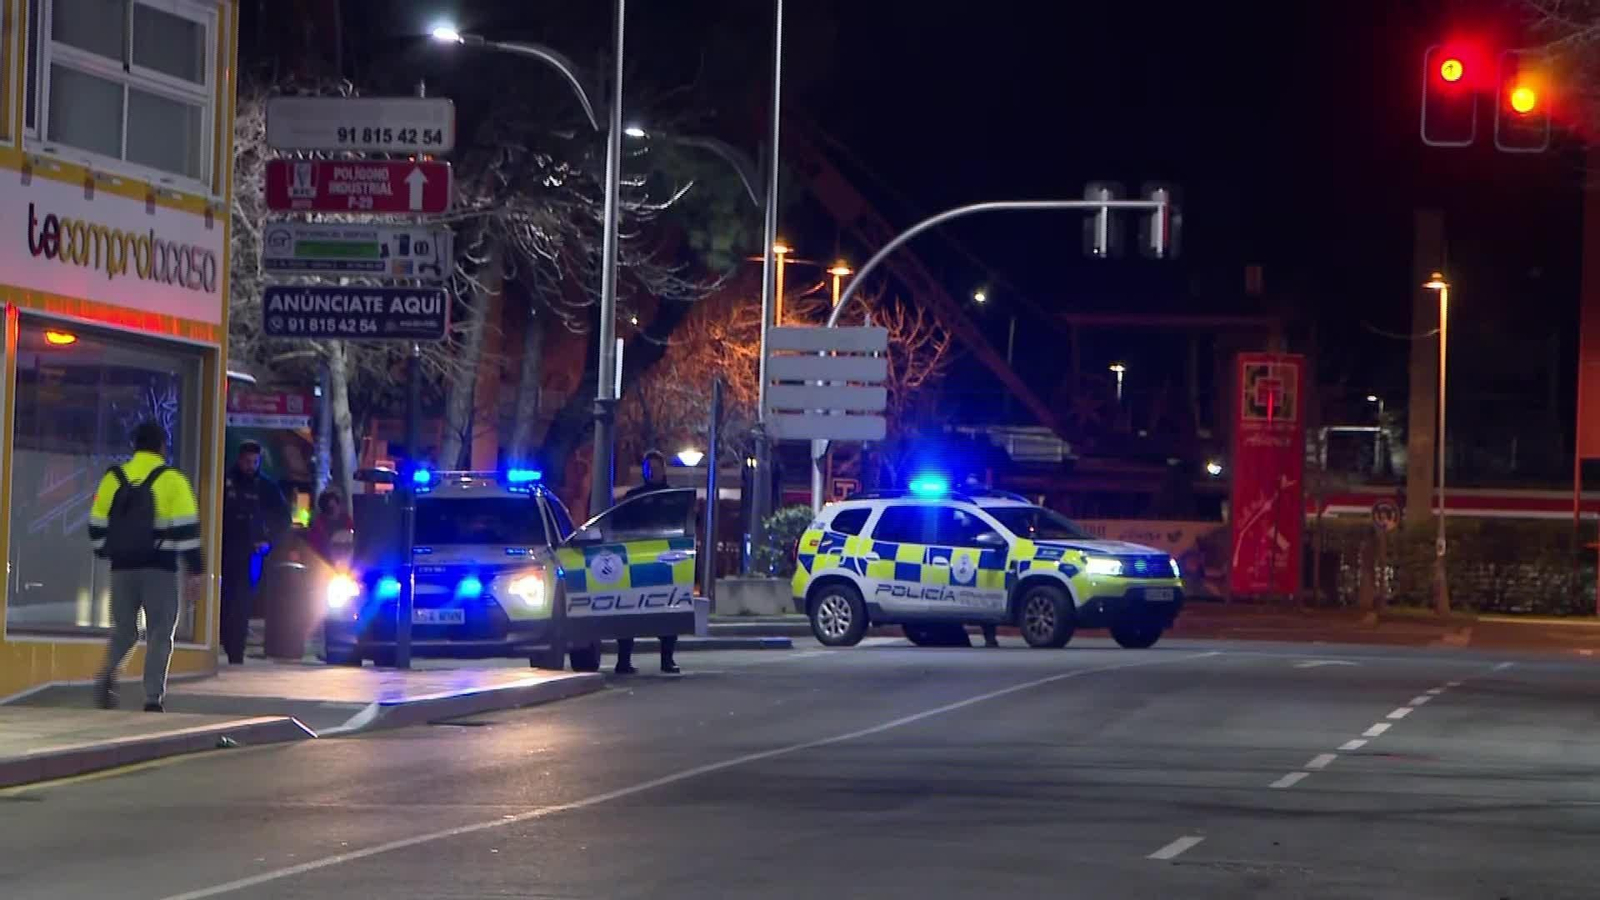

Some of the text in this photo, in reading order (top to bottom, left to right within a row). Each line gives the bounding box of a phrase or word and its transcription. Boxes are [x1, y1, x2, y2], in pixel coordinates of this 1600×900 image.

[337, 126, 443, 145] 91 815 42 54
[328, 180, 394, 196] INDUSTRIAL
[268, 289, 442, 314] ANÚNCIATE AQUÍ
[287, 316, 378, 333] 91 815 42 54
[567, 586, 694, 612] POLICÍA
[875, 583, 957, 602] POLICÍA
